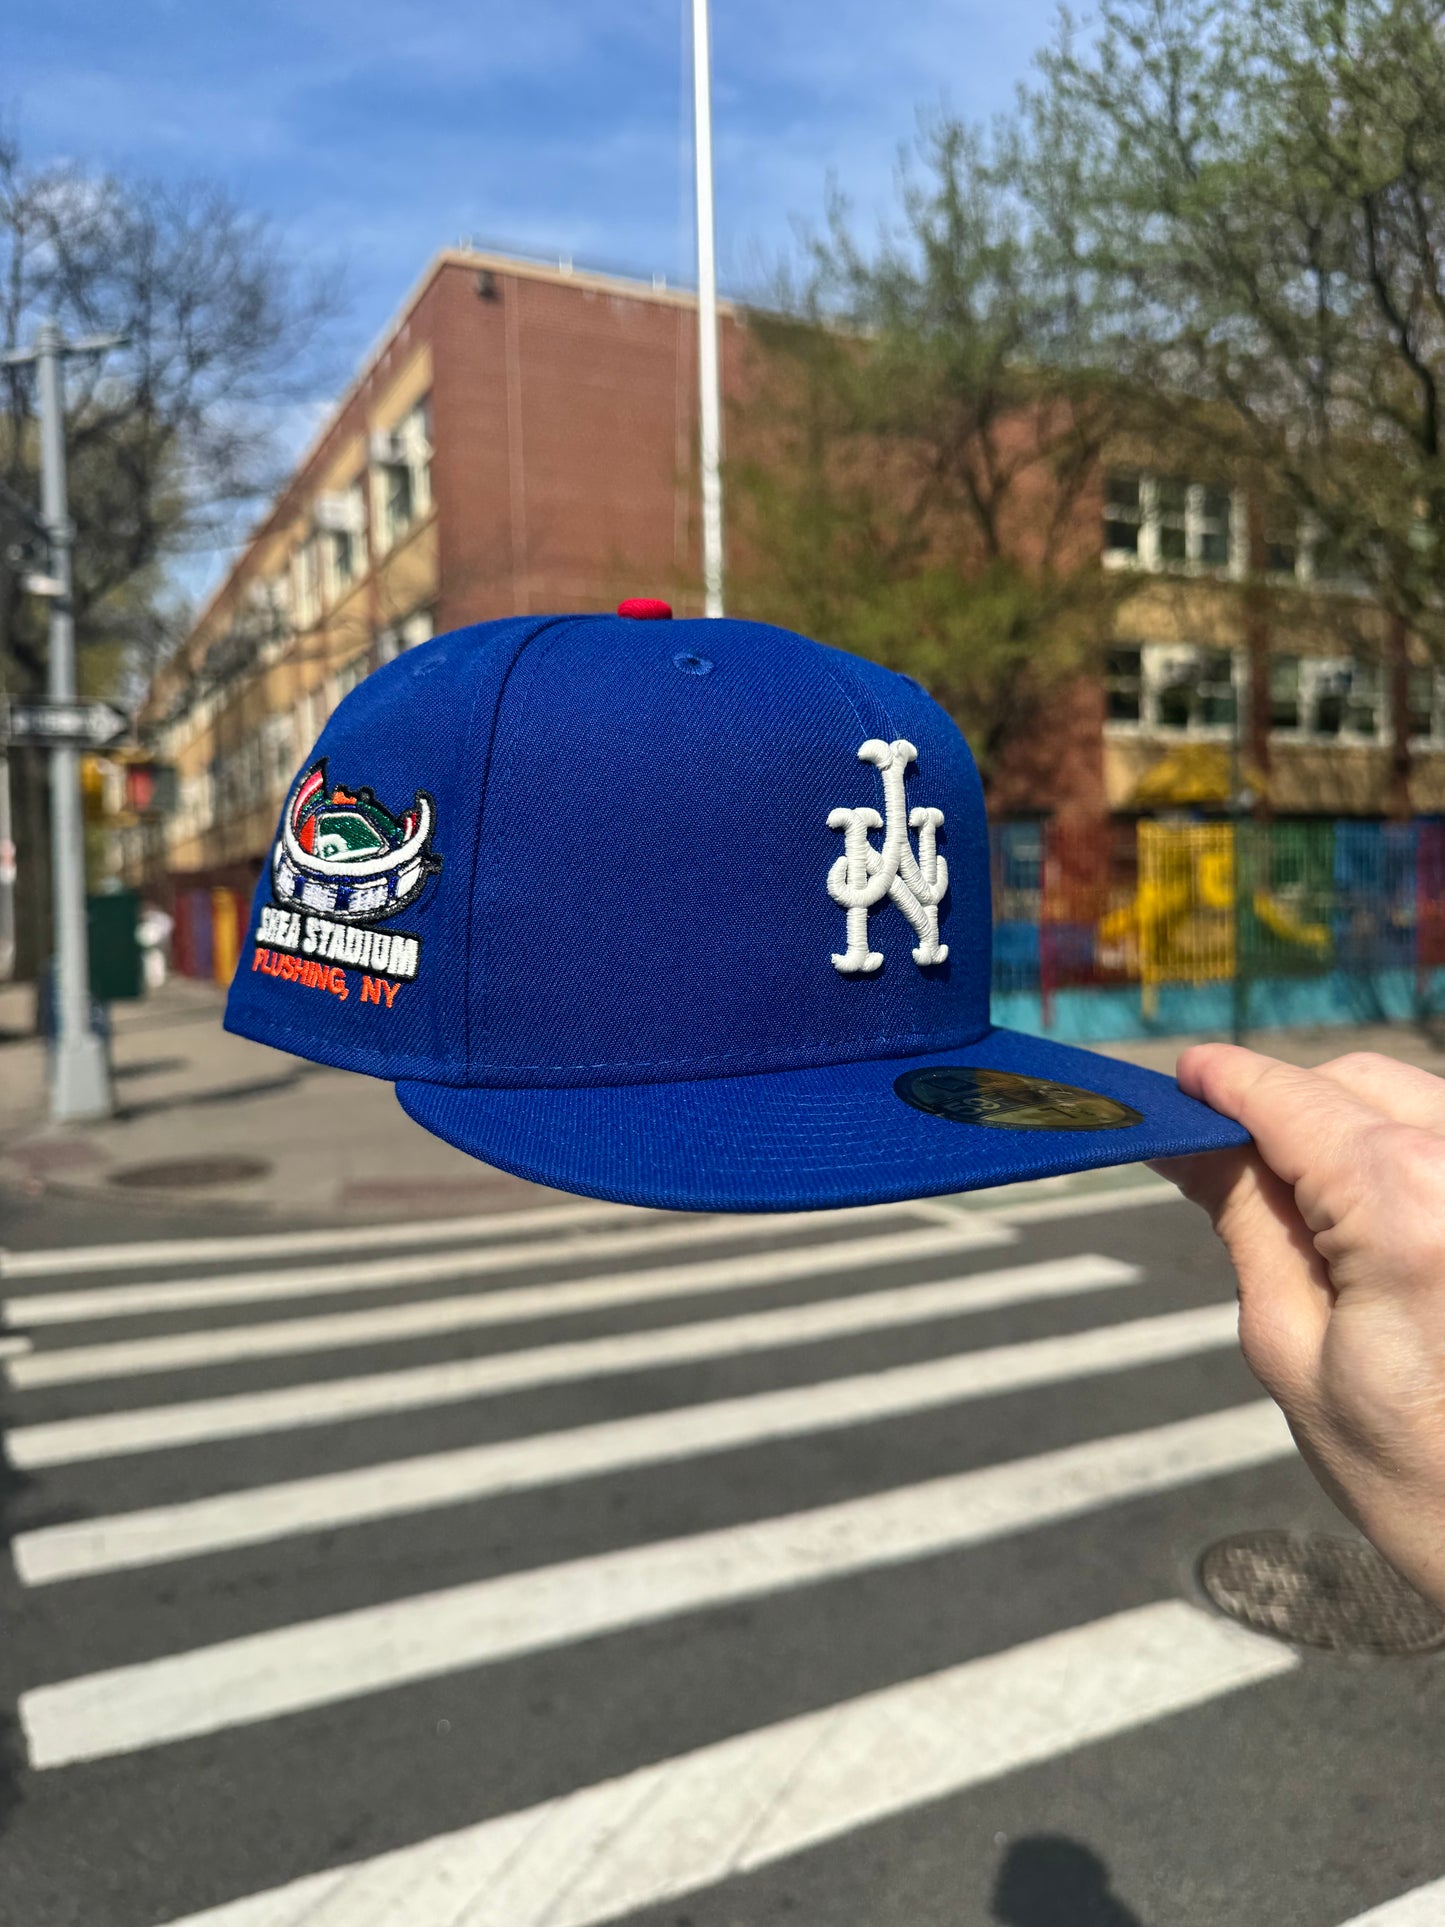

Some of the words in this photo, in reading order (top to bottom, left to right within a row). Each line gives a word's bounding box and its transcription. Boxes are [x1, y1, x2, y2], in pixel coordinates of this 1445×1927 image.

[826, 738, 949, 973] NY
[255, 906, 302, 949] SHEA
[302, 916, 419, 977] STADIUM
[252, 948, 350, 1001] FLUSHING,
[360, 974, 401, 1009] NY
